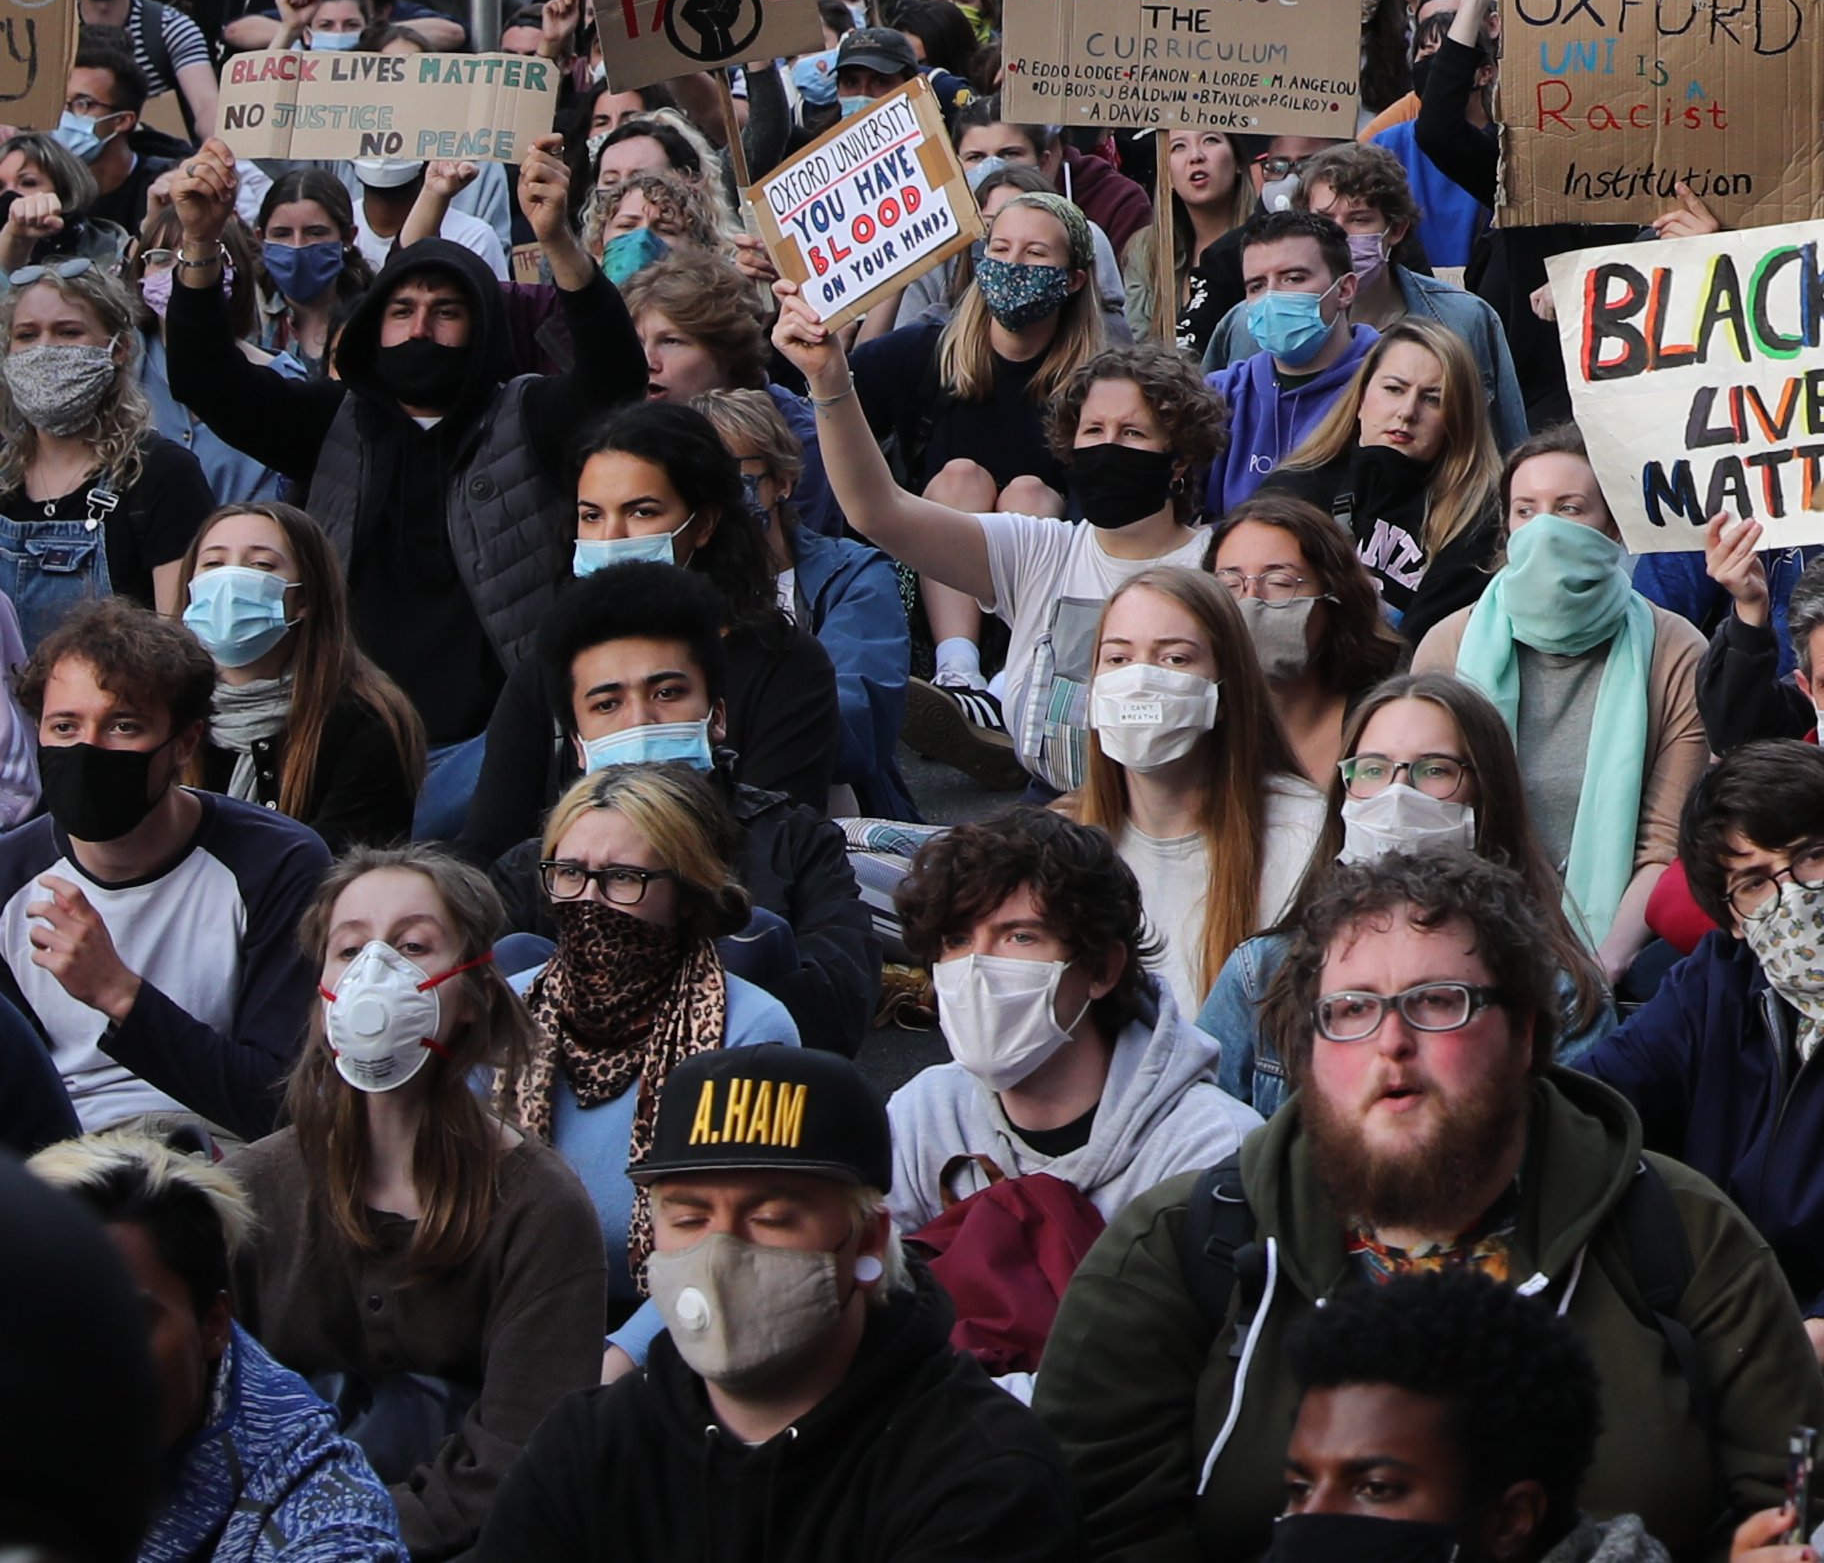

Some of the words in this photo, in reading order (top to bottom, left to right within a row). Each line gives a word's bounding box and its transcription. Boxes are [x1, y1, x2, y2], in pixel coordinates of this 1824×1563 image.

[1142, 5, 1212, 33] THE
[1086, 32, 1288, 64] CURRICULUM
[1540, 38, 1618, 75] UNI
[1636, 54, 1669, 86] IS
[1686, 80, 1706, 100] A
[231, 55, 320, 85] BLACK
[331, 57, 406, 83] LIVES
[418, 57, 548, 92] MATTER
[1074, 64, 1123, 81] LODGE
[224, 103, 264, 130] NO
[271, 103, 394, 130] JUSTICE
[1536, 79, 1728, 132] Racist
[359, 132, 404, 157] NO
[416, 128, 515, 159] PEACE
[769, 156, 830, 216] OXFORD
[830, 96, 916, 174] UNIVERSITY
[792, 189, 845, 244] YOU
[853, 144, 916, 206] HAVE
[1564, 162, 1752, 201] Institution
[808, 185, 922, 277] BLOOD
[822, 274, 846, 303] ON
[850, 240, 898, 282] YOUR
[900, 207, 949, 252] HANDS
[688, 1079, 807, 1148] A.HAM
